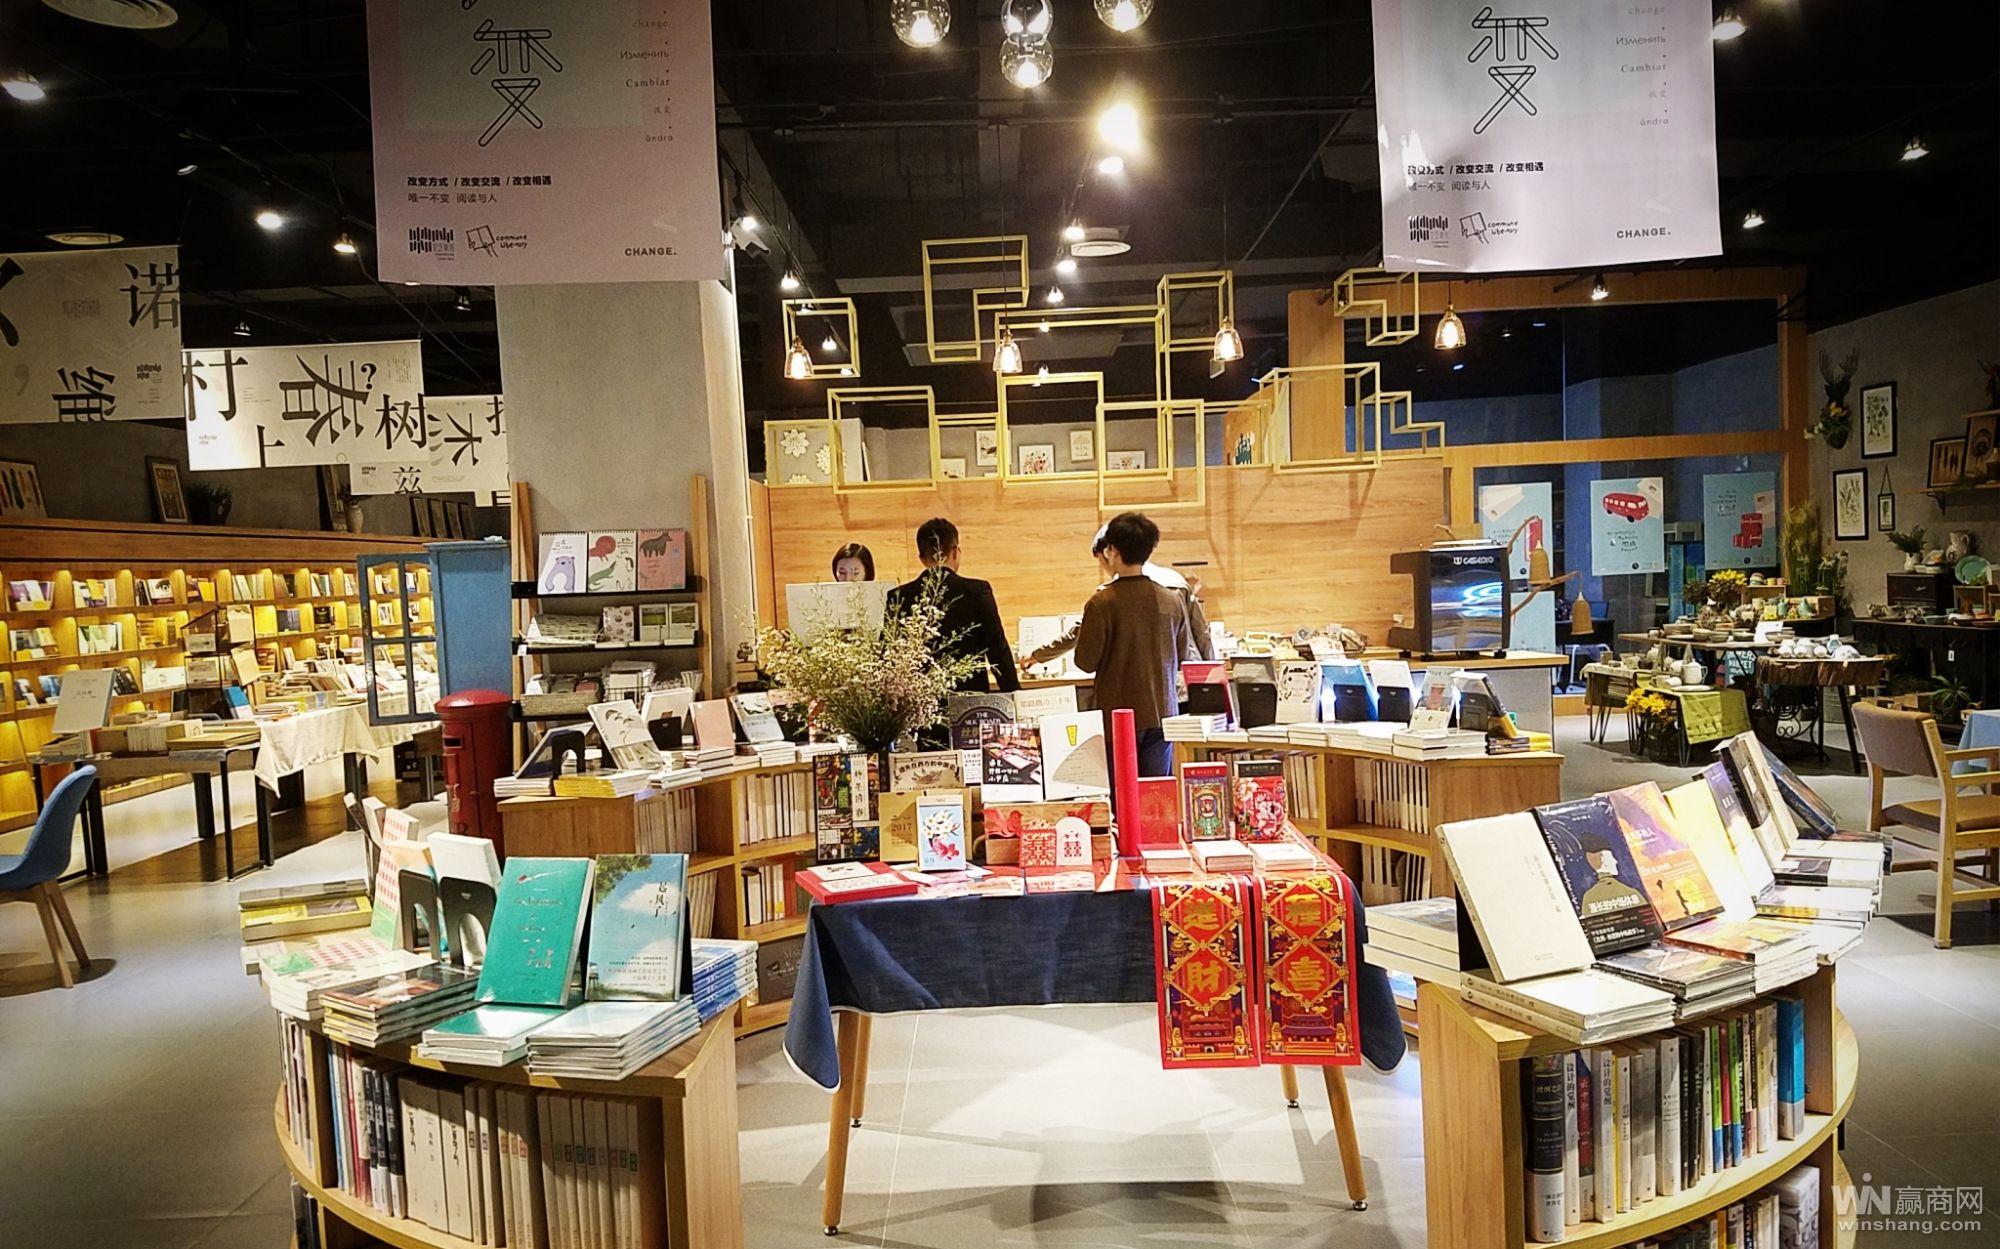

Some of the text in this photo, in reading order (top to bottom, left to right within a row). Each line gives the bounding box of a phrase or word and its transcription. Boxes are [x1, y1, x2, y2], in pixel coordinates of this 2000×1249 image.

[1616, 35, 1666, 45] Изменить
[1621, 63, 1666, 73] Cambiar
[625, 78, 670, 88] Cambiar
[1455, 163, 1494, 174] 改变交流
[1506, 161, 1544, 172] 改变相遇
[407, 176, 449, 187] 改变方式
[460, 177, 501, 187] 改变交流
[512, 175, 552, 186] 改变相遇
[1451, 180, 1491, 191] 阅读与人
[407, 192, 498, 204] 唯一不变 阅读与人
[1616, 227, 1671, 239] CHANGE.
[624, 247, 677, 257] CHANGE.
[120, 262, 180, 329] 诺
[891, 823, 912, 832] 2017
[655, 880, 667, 918] 起风了
